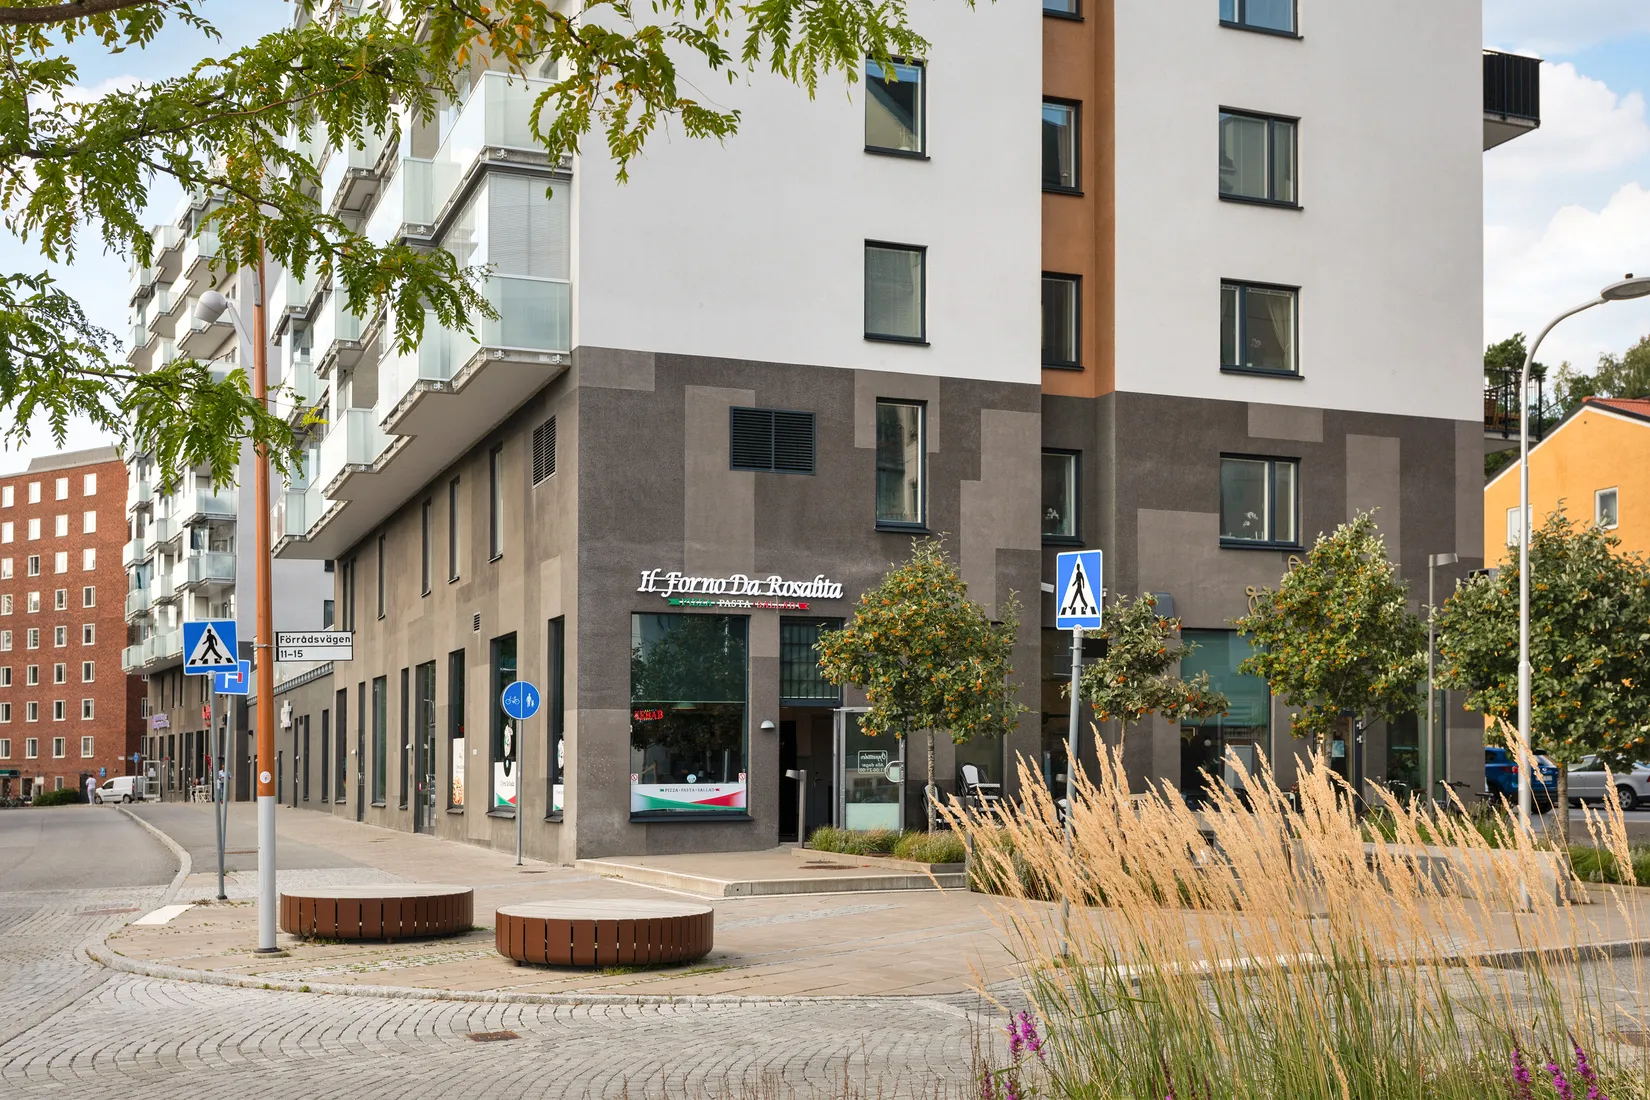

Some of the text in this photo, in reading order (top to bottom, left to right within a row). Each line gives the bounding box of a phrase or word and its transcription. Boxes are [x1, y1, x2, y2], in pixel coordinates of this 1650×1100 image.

[661, 571, 726, 597] Forno
[729, 573, 761, 596] Da
[766, 574, 844, 599] Rosalita
[718, 599, 752, 608] PASTA
[756, 600, 797, 610] SALLAD
[280, 635, 351, 645] Förrådsvägen
[280, 650, 303, 658] 11-15
[633, 709, 664, 720] KEBAB
